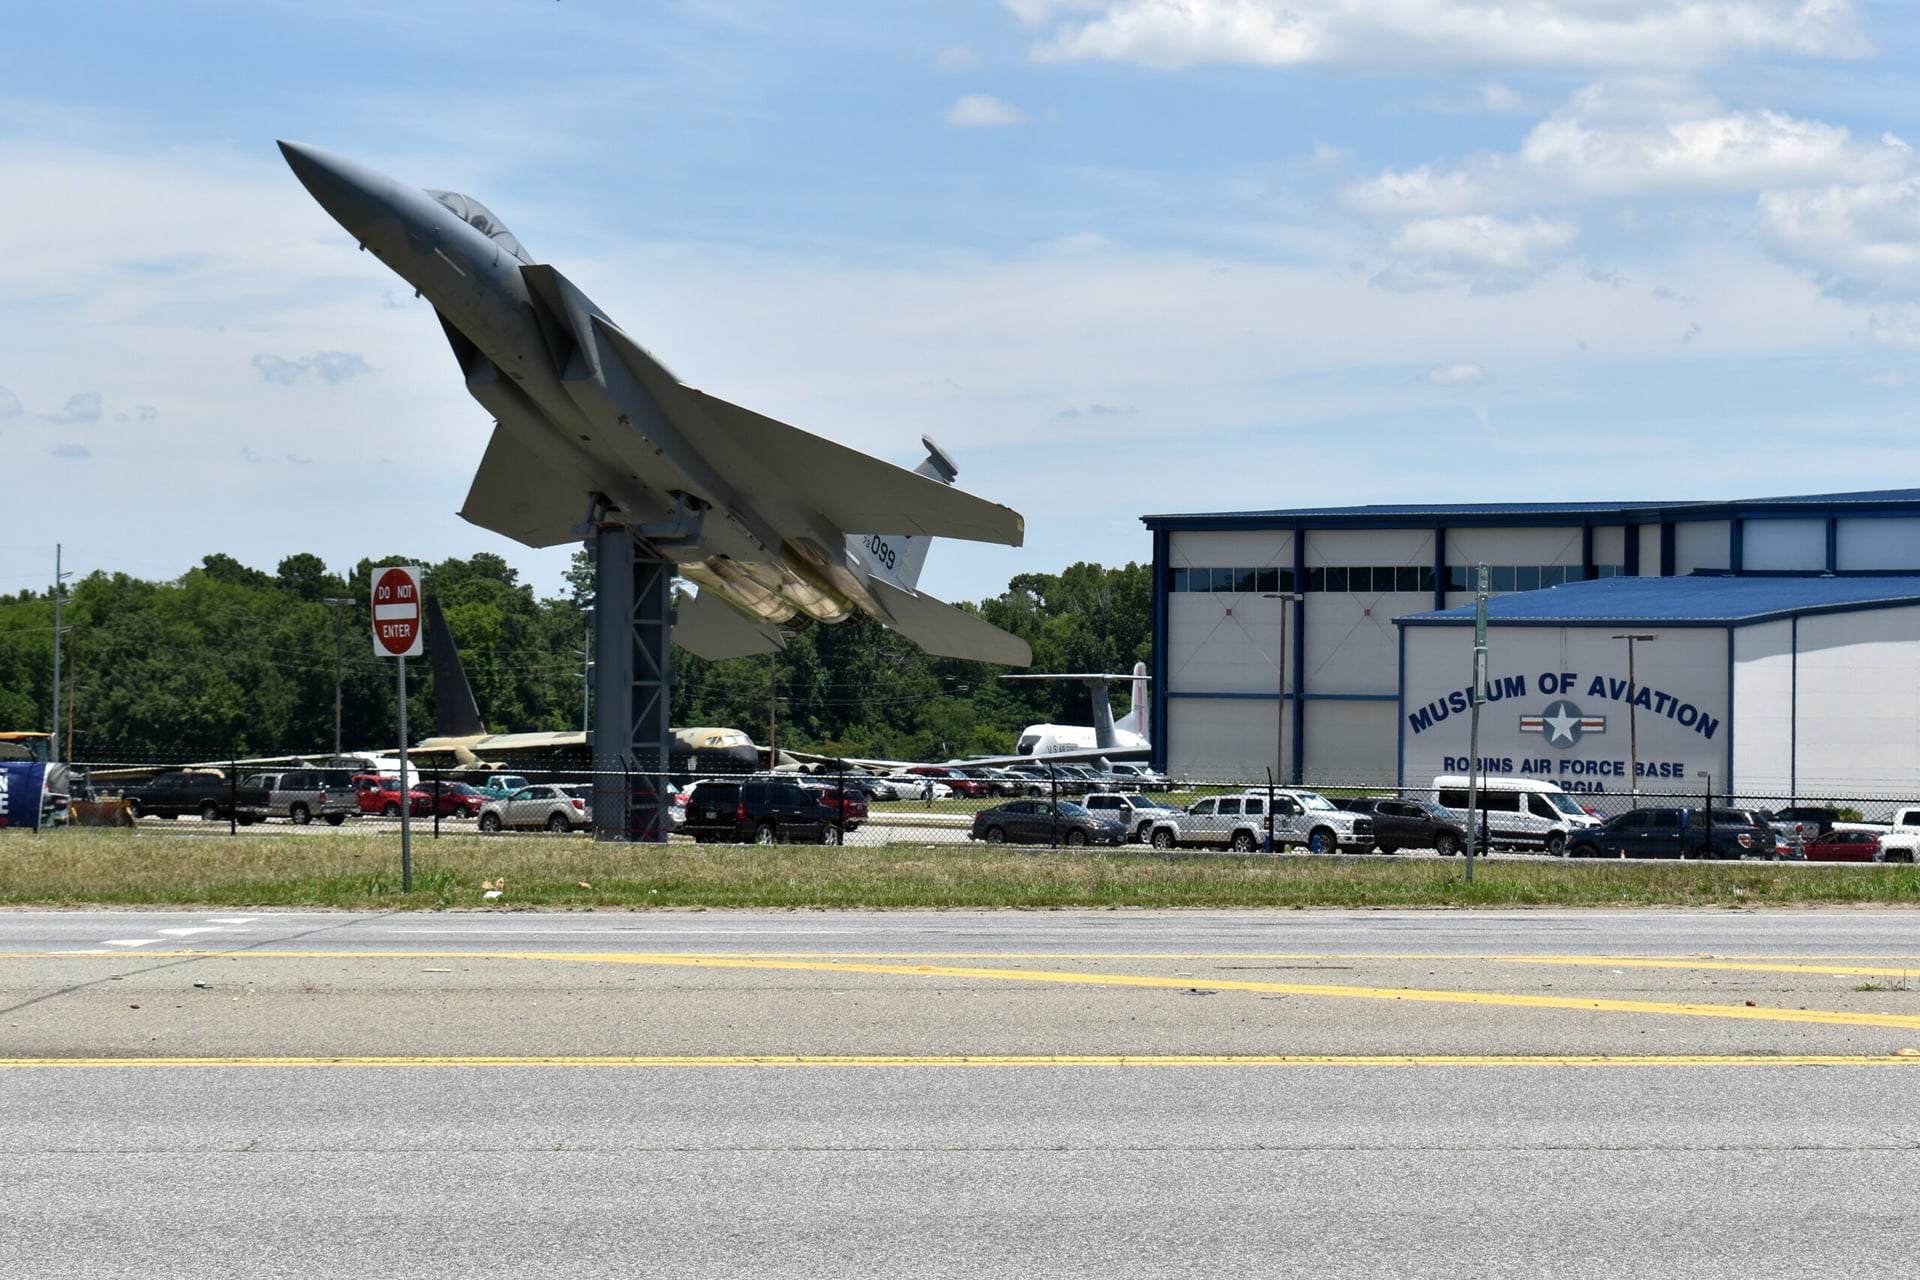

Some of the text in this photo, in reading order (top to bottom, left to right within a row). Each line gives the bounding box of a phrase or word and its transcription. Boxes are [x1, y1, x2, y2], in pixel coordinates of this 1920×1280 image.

[871, 535, 896, 570] 099
[379, 584, 413, 600] DO NOT
[383, 624, 411, 638] ENTER
[1538, 672, 1577, 695] OF
[1587, 675, 1719, 740] AVIATION
[1520, 758, 1551, 774] AIR
[1560, 760, 1625, 776] FORCE
[1635, 762, 1685, 778] BASE
[1547, 780, 1605, 793] RGIA
